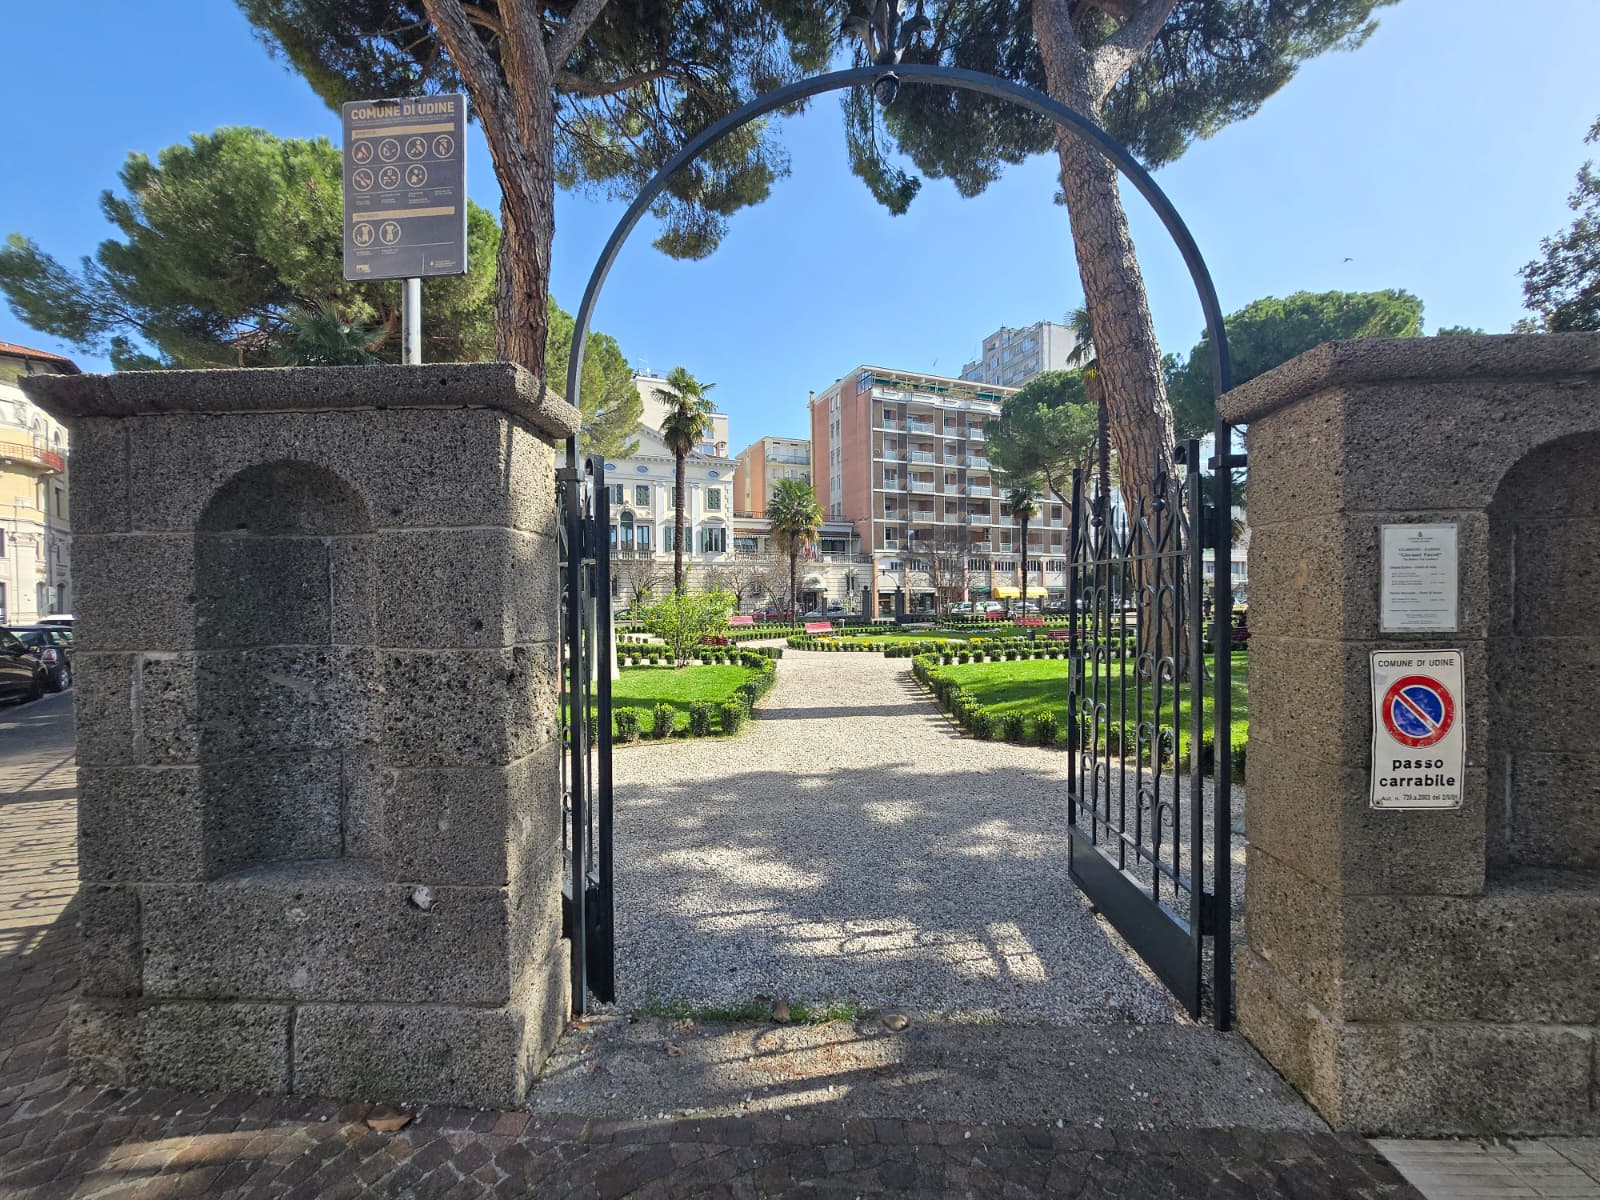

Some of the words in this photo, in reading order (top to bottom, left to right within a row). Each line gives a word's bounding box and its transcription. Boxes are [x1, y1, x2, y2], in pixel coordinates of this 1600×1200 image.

[351, 106, 400, 120] COMUNE
[403, 105, 415, 116] DI
[418, 102, 454, 114] UDINE
[1417, 659, 1424, 667] DI
[1429, 658, 1455, 666] UDINE
[1392, 759, 1444, 771] passo
[1379, 774, 1456, 787] carrabile
